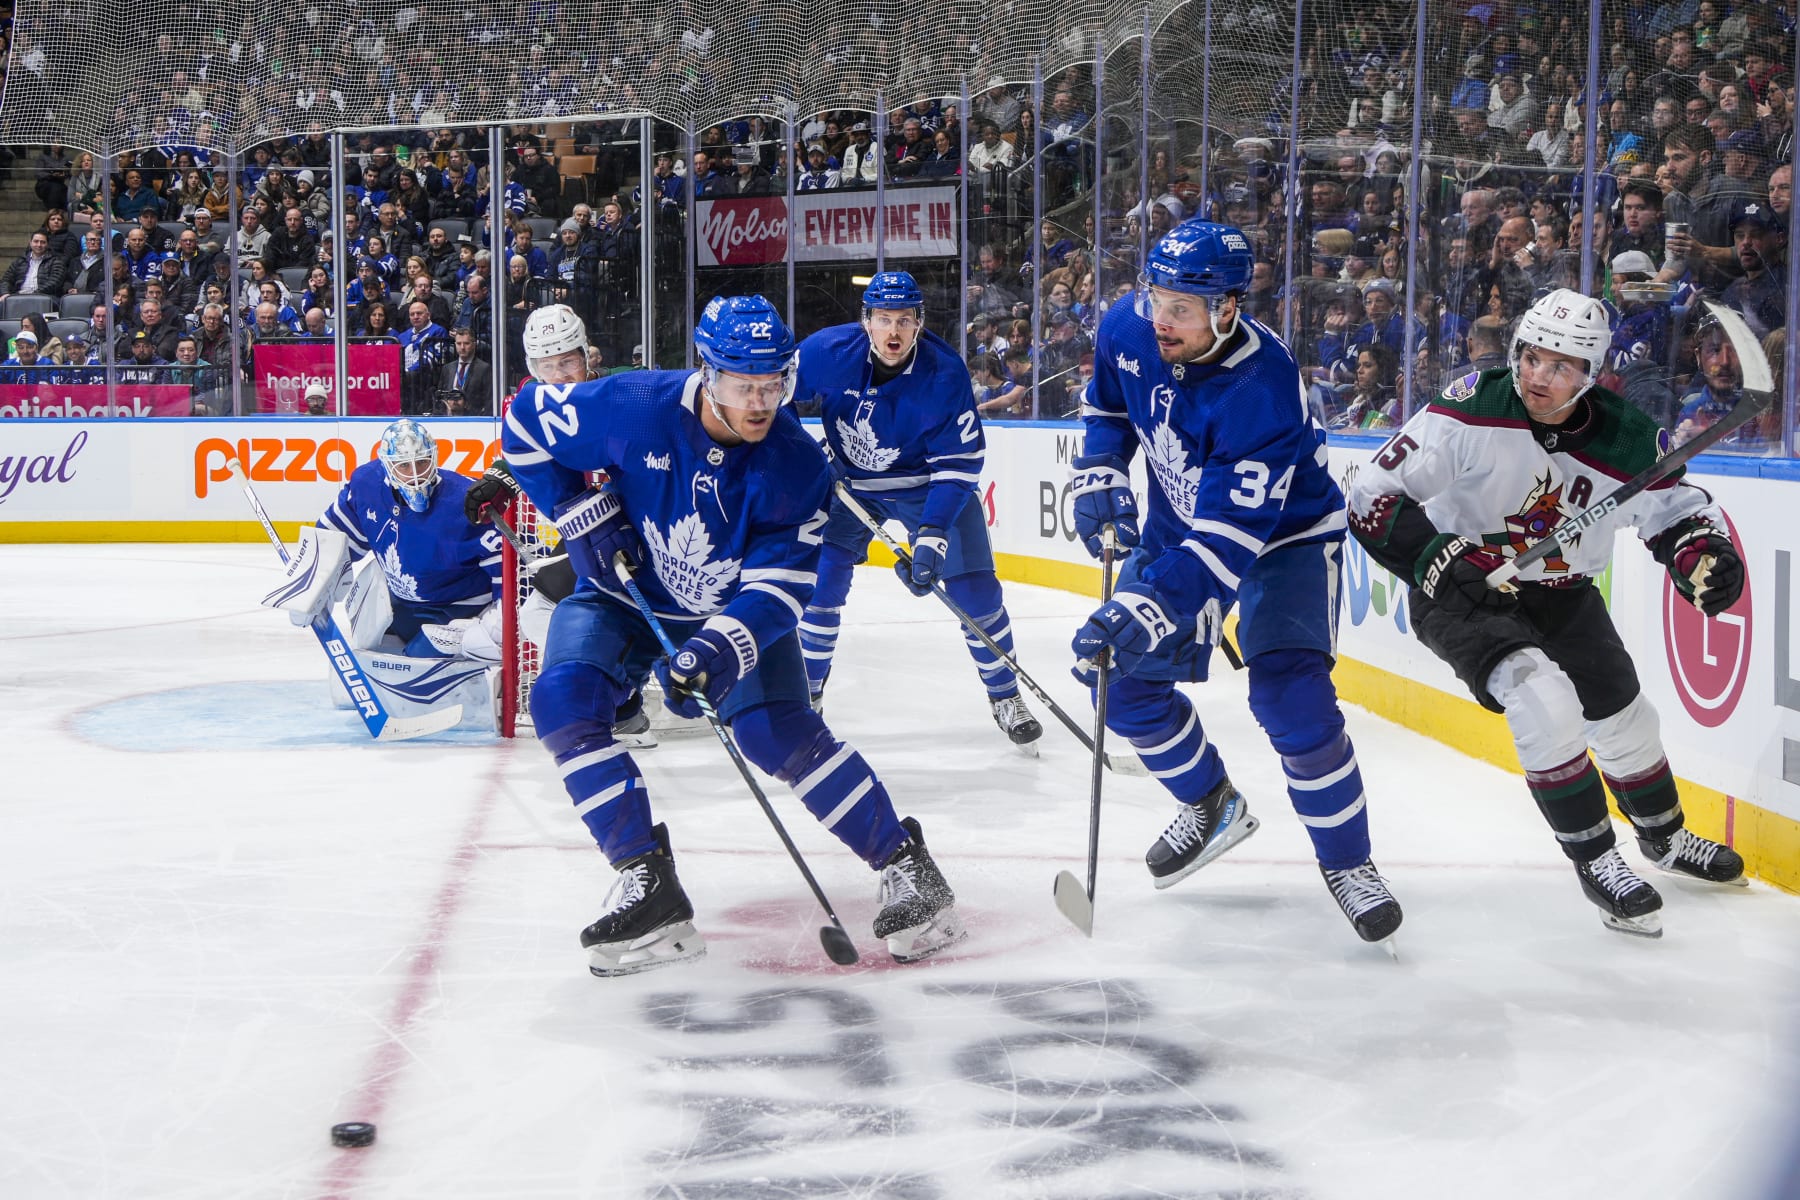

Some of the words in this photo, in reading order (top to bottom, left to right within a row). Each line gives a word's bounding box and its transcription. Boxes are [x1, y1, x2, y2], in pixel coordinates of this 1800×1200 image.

[929, 202, 950, 241] IN
[1163, 239, 1187, 257] 34
[1221, 234, 1243, 246] pizza
[1228, 241, 1248, 252] pizza
[1151, 261, 1178, 276] CCM
[1553, 306, 1571, 320] 15
[749, 322, 772, 338] 22
[1115, 352, 1141, 377] Milk
[267, 371, 333, 393] hockey
[347, 376, 364, 390] or
[367, 372, 390, 390] all
[535, 382, 580, 447] 22
[957, 410, 979, 444] 2
[643, 451, 671, 472] Milk
[847, 434, 886, 462] TORONTO
[1056, 434, 1086, 465] MA
[1371, 431, 1420, 472] 15
[194, 437, 357, 499] pizza
[1229, 460, 1296, 511] 34
[1567, 474, 1594, 510] A
[1117, 495, 1132, 507] 34
[1119, 522, 1137, 536] CCM
[286, 537, 309, 577] BAUER
[654, 548, 718, 588] TORONTO
[1422, 536, 1473, 600] BAUER
[661, 571, 703, 601] LEAFS
[662, 562, 705, 592] MAPLE
[1104, 608, 1121, 623] 34
[325, 638, 379, 720] BAUER
[371, 660, 412, 673] BAUER
[1223, 804, 1235, 825] AM34
